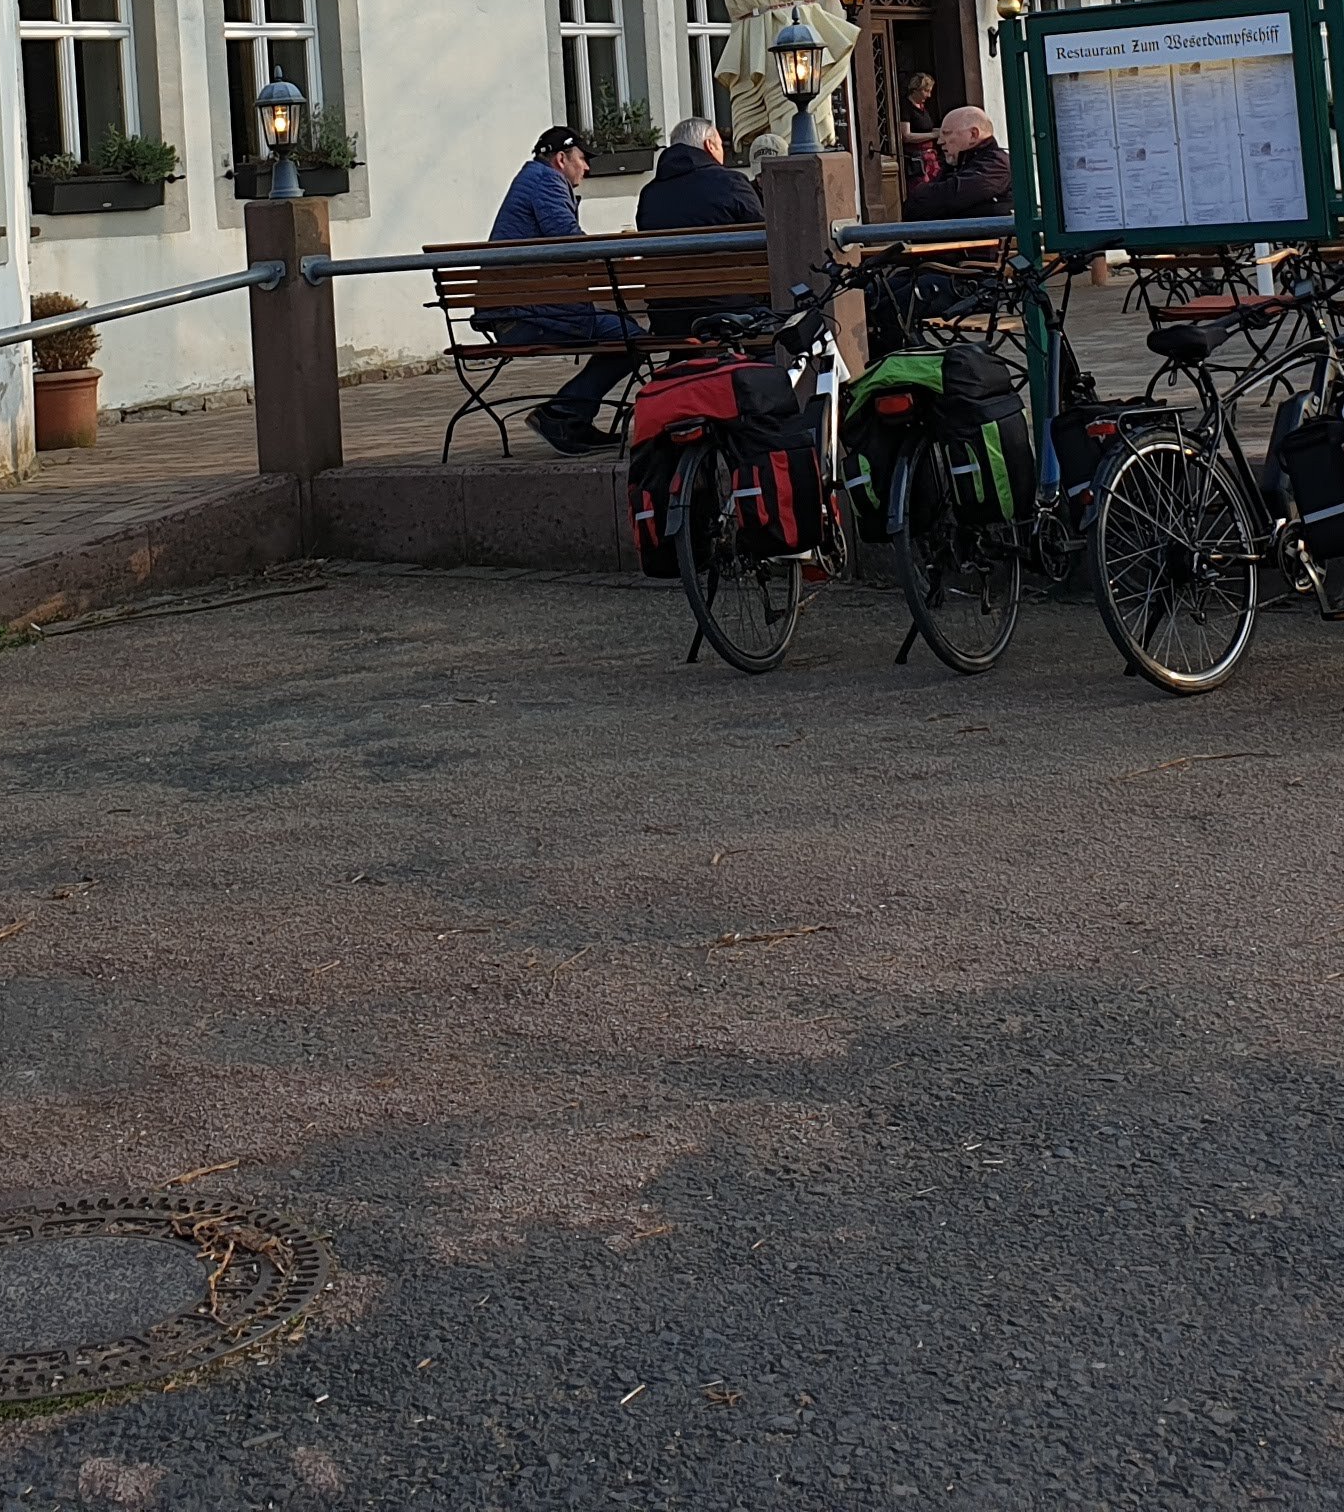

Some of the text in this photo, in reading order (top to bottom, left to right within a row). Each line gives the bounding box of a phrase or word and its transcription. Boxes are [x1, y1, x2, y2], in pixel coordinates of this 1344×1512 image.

[1056, 24, 1281, 60] Restaurant Zum Weserdampfschiff
